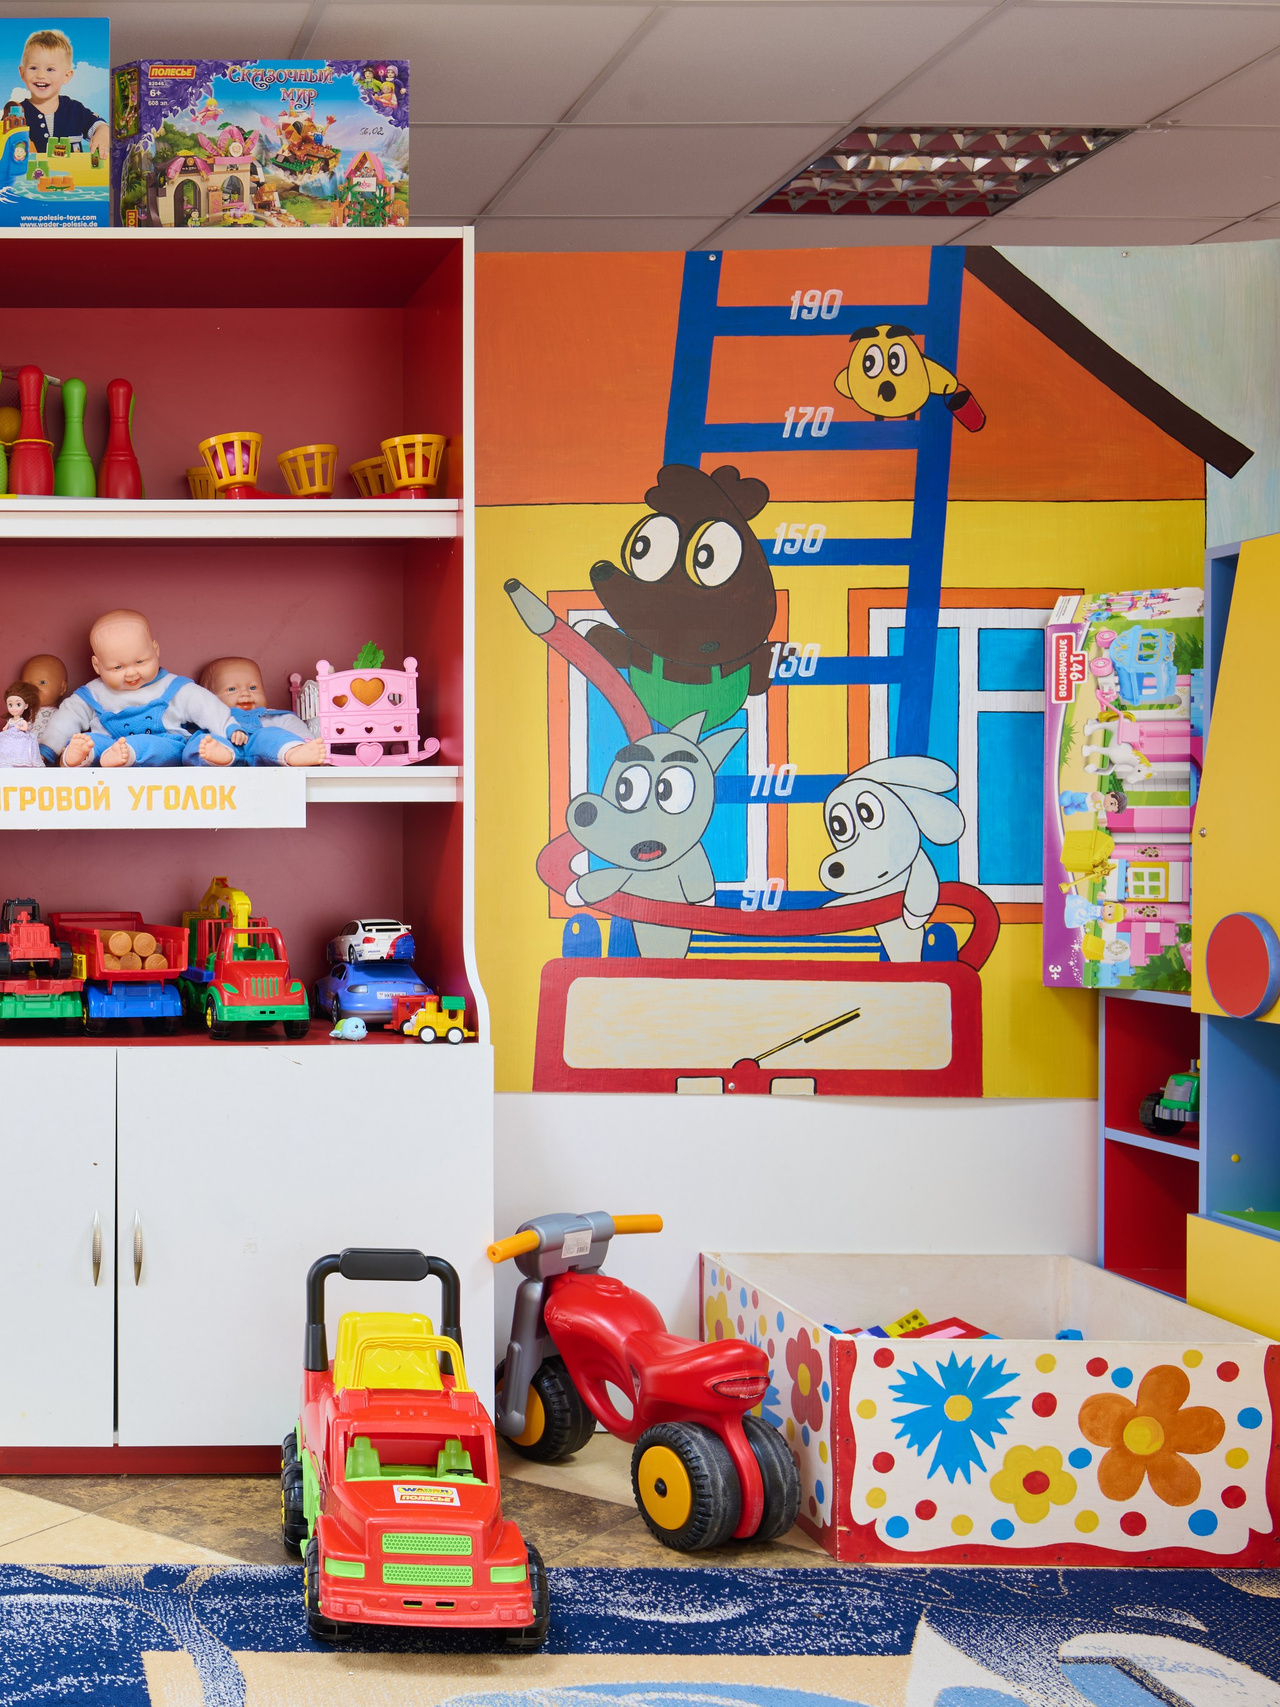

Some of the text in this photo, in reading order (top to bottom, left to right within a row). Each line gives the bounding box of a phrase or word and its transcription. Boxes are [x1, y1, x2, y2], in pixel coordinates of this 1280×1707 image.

[151, 68, 193, 77] ПОЛЕСЬЕ
[149, 89, 162, 98] 6+
[20, 214, 97, 222] www.polesie-toys.com
[790, 289, 843, 320] 190
[782, 406, 834, 438] 170
[772, 522, 826, 555] 150
[768, 642, 821, 679] 130
[1058, 639, 1068, 698] элементов
[1069, 655, 1083, 681] 146
[750, 763, 797, 797] 110
[127, 785, 237, 811] УГОЛОК
[740, 877, 784, 911] 90
[1048, 964, 1062, 980] 3+
[401, 1494, 451, 1502] ПОЛЕСЬЕ
